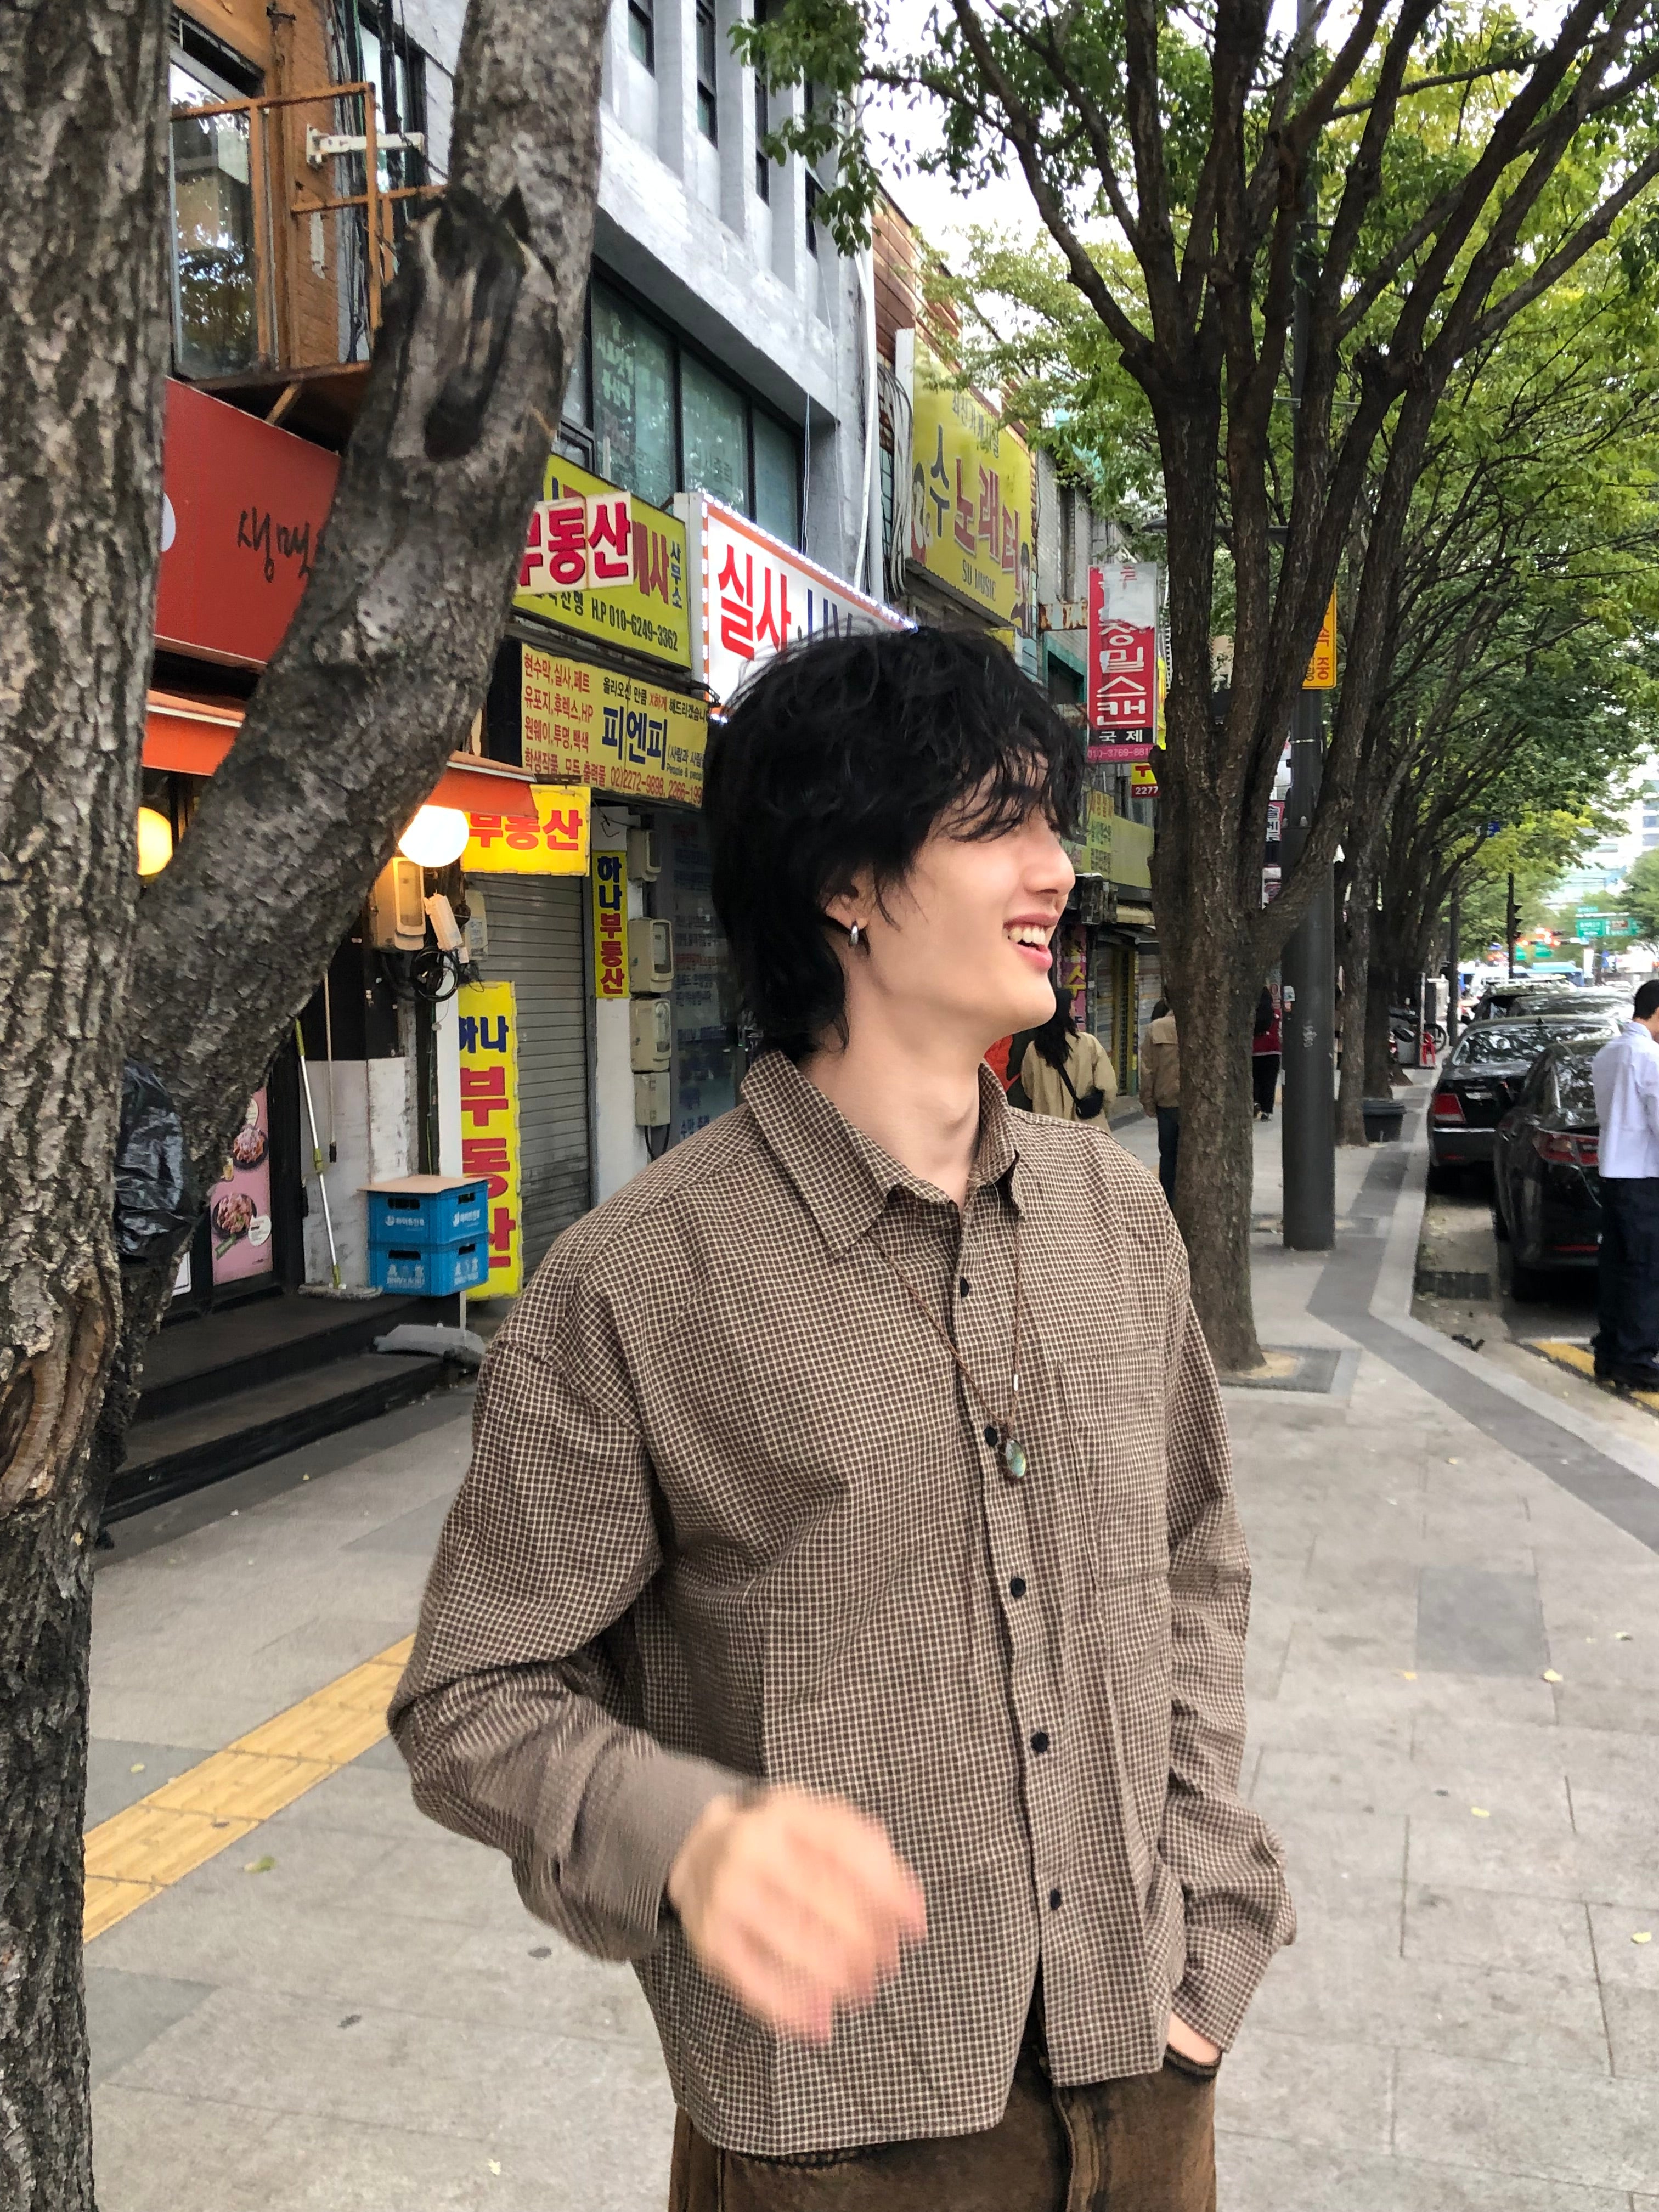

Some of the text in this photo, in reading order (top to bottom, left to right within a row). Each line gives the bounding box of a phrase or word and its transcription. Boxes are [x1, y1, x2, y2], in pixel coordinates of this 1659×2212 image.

[962, 559, 996, 601] SU MUSIC
[591, 597, 606, 624] H.P
[609, 605, 678, 651] 010-6249-3362
[634, 687, 647, 706] 만큼
[602, 706, 667, 770] 피엔피
[1088, 747, 1151, 758] 010-3769-881
[470, 810, 583, 851] 부동산
